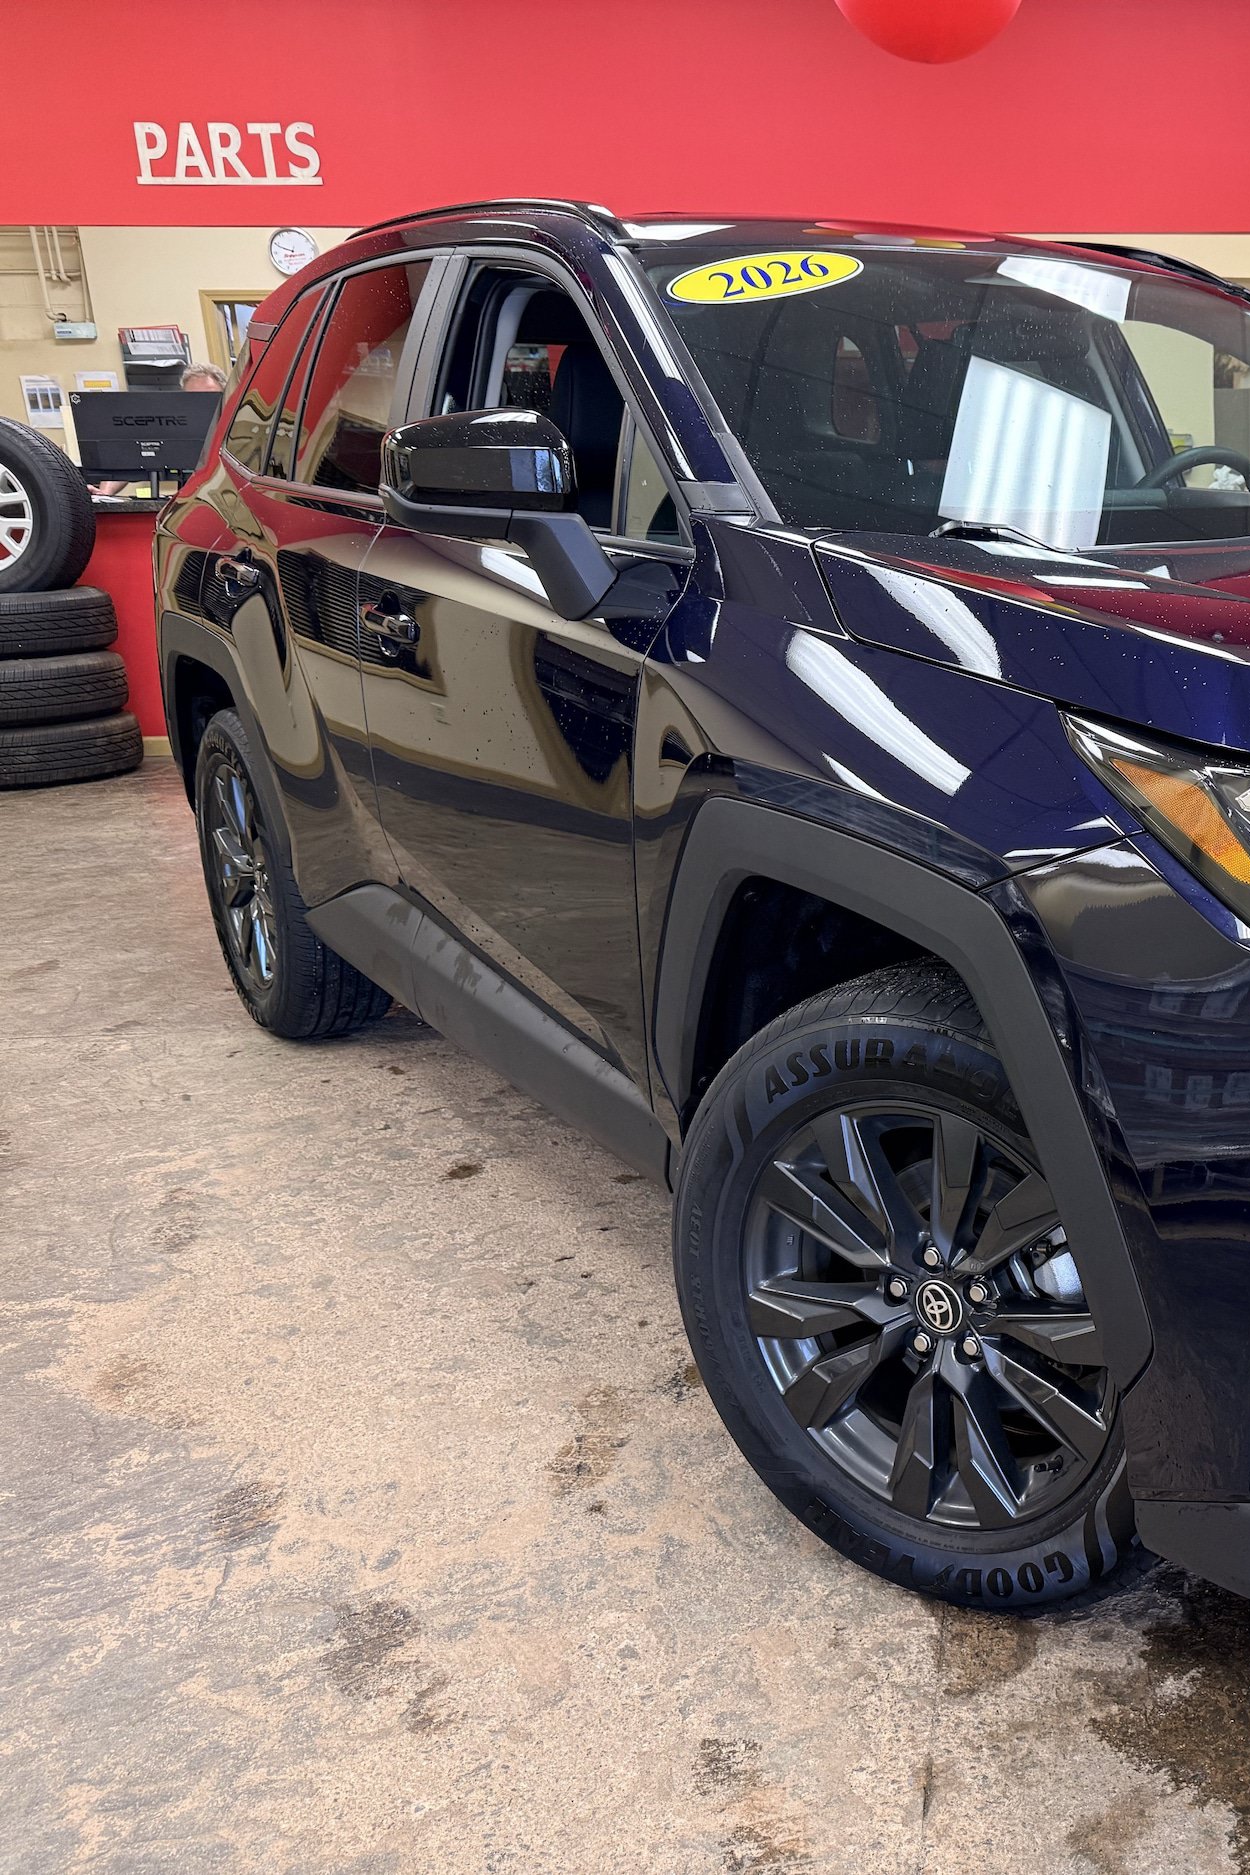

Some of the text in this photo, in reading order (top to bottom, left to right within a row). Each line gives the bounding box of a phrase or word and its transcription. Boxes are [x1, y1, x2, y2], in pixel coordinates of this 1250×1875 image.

[133, 121, 323, 180] PARTS
[708, 254, 829, 298] 2026
[112, 415, 188, 426] SCEPTRE
